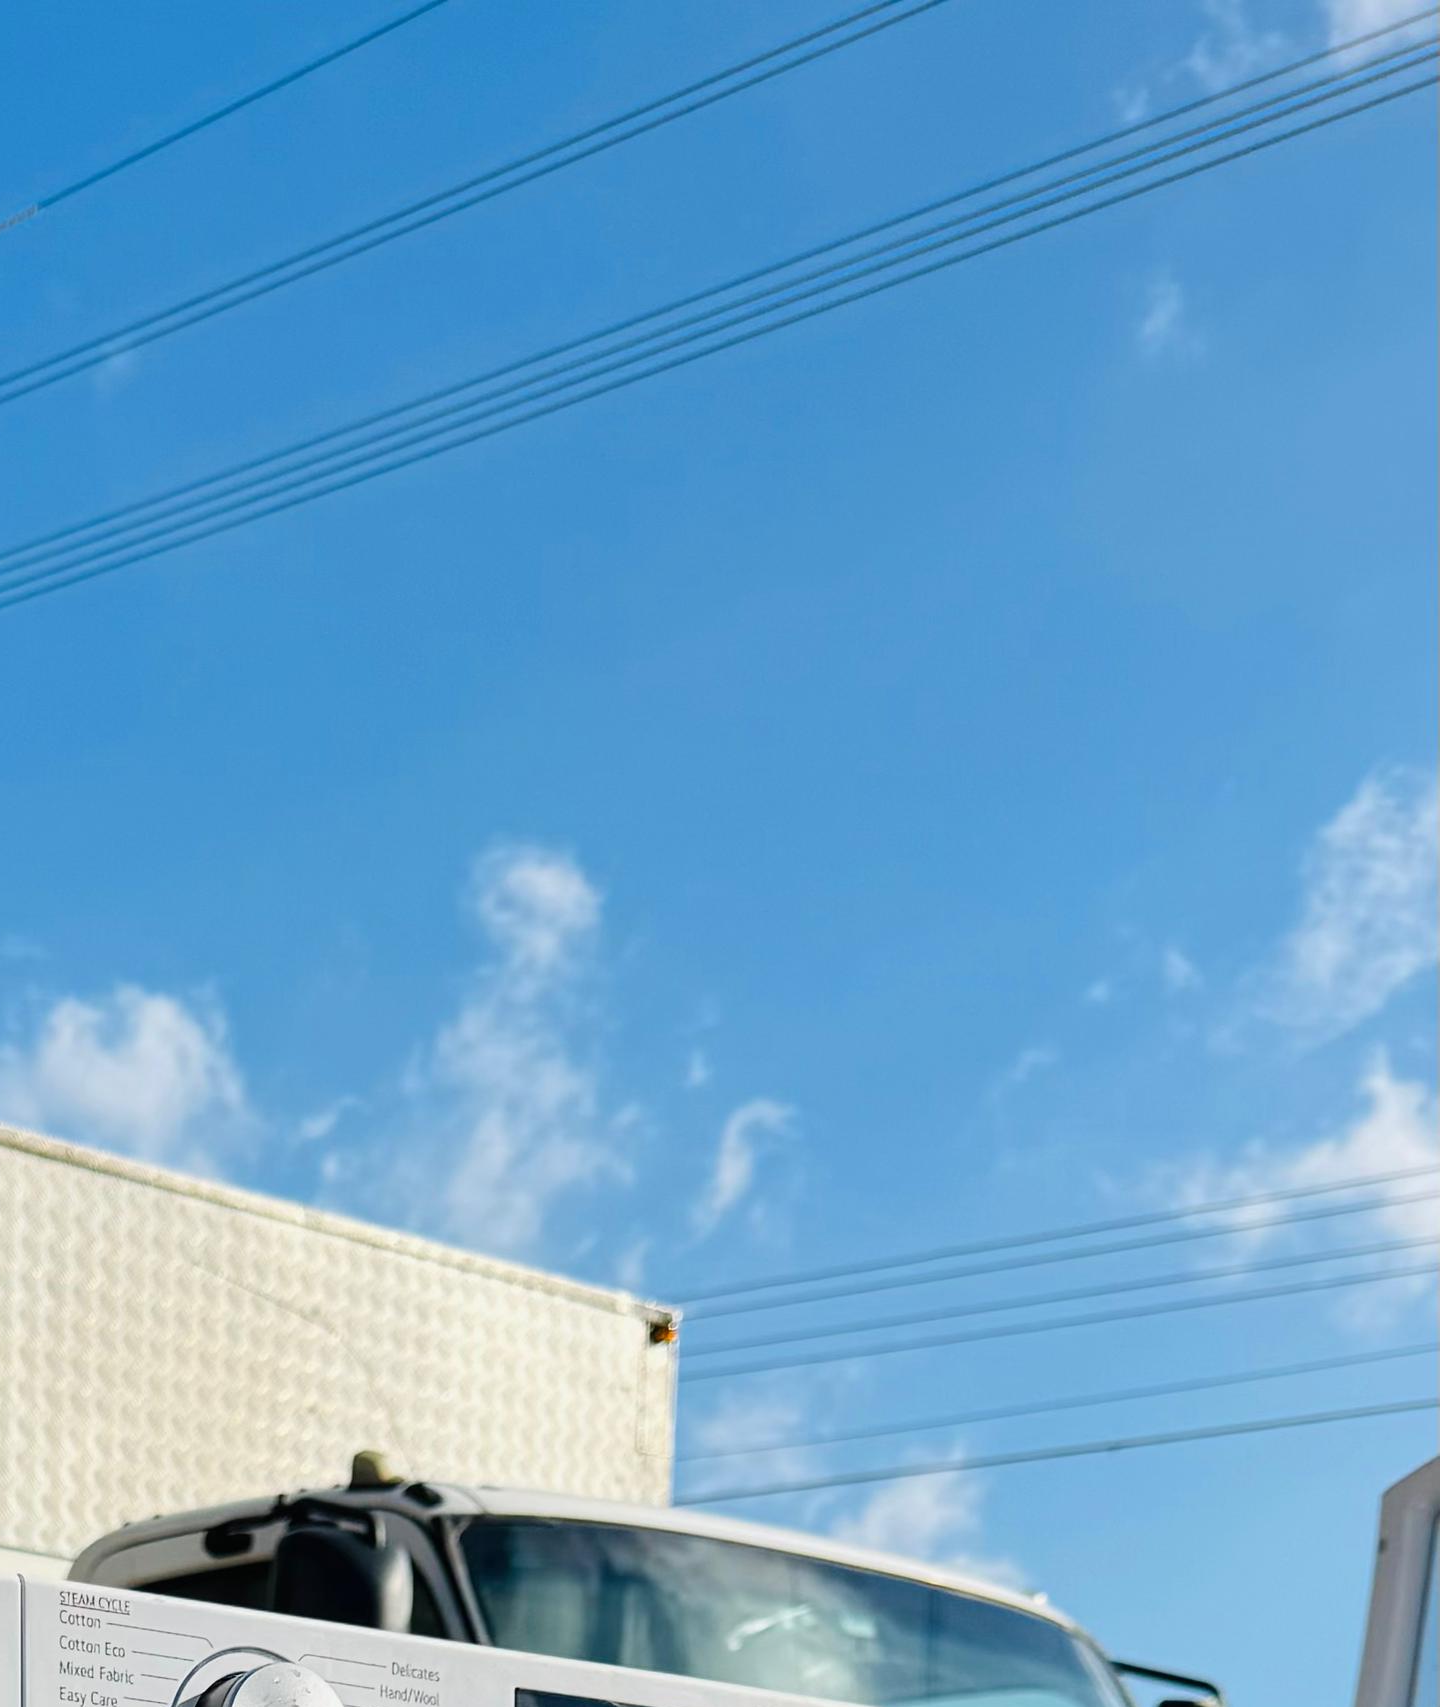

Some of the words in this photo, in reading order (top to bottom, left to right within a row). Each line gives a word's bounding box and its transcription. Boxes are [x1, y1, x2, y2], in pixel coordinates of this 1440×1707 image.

[60, 1591, 95, 1606] STEAM
[98, 1597, 130, 1613] CYCLE
[60, 1610, 101, 1628] Cotton
[60, 1635, 100, 1654] Cotton
[105, 1642, 125, 1658] Eco
[60, 1661, 94, 1678] Mixed
[100, 1666, 134, 1684] Fabric
[392, 1662, 440, 1682] Delicates
[60, 1687, 86, 1707] Easy
[91, 1692, 117, 1707] Care
[380, 1684, 439, 1706] Hand/Wool
